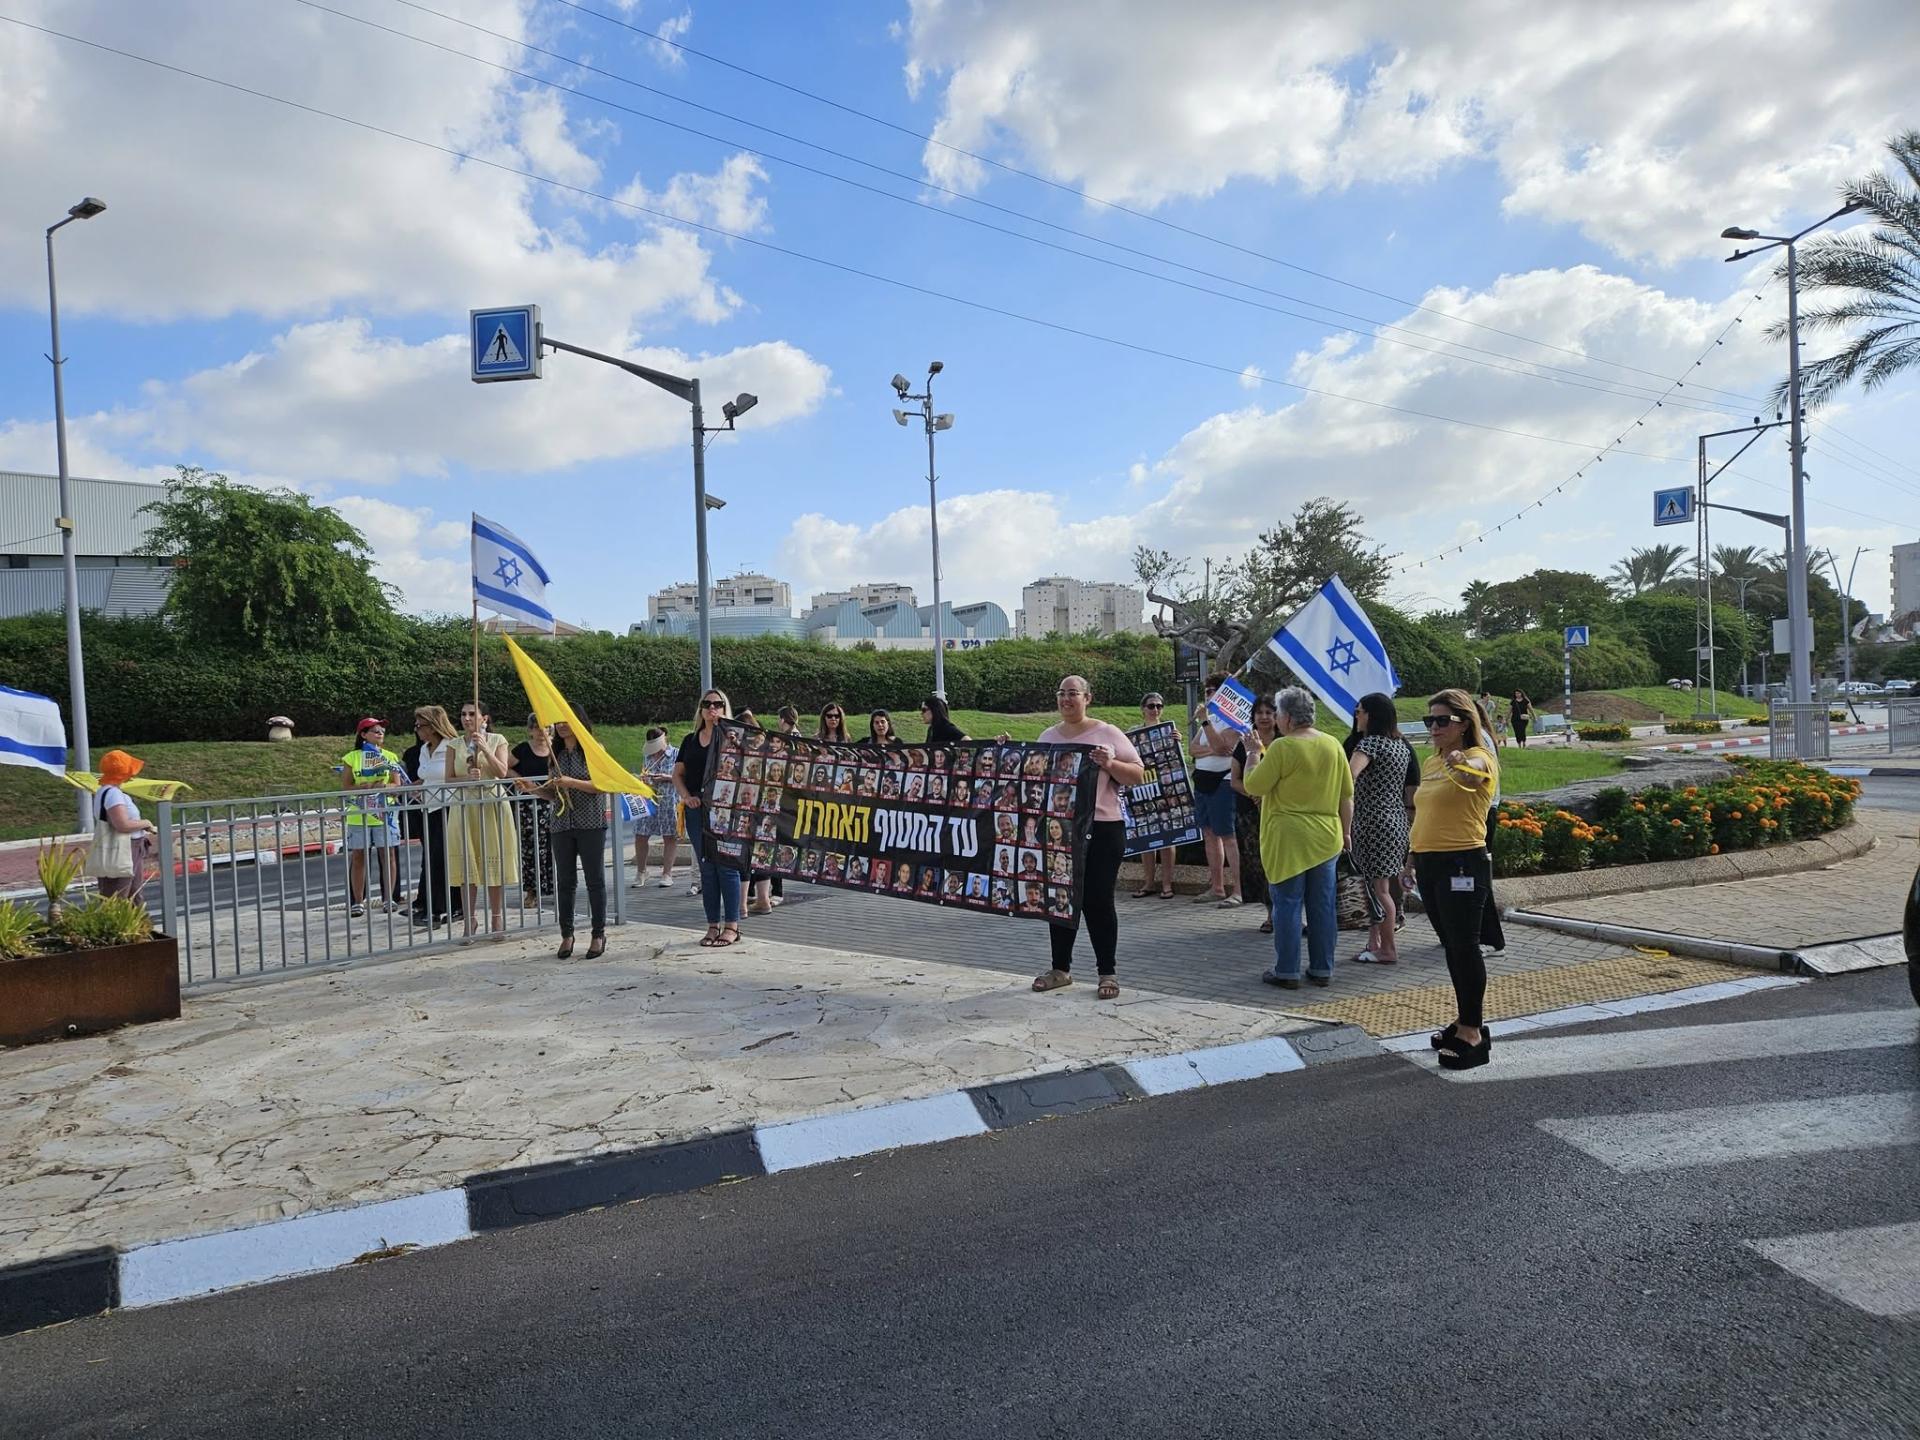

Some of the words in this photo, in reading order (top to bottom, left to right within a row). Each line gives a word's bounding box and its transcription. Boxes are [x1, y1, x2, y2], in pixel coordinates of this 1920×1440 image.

[1221, 686, 1239, 702] אותם
[793, 798, 871, 844] האחרון
[873, 808, 945, 853] החטוף
[948, 817, 979, 857] עד
